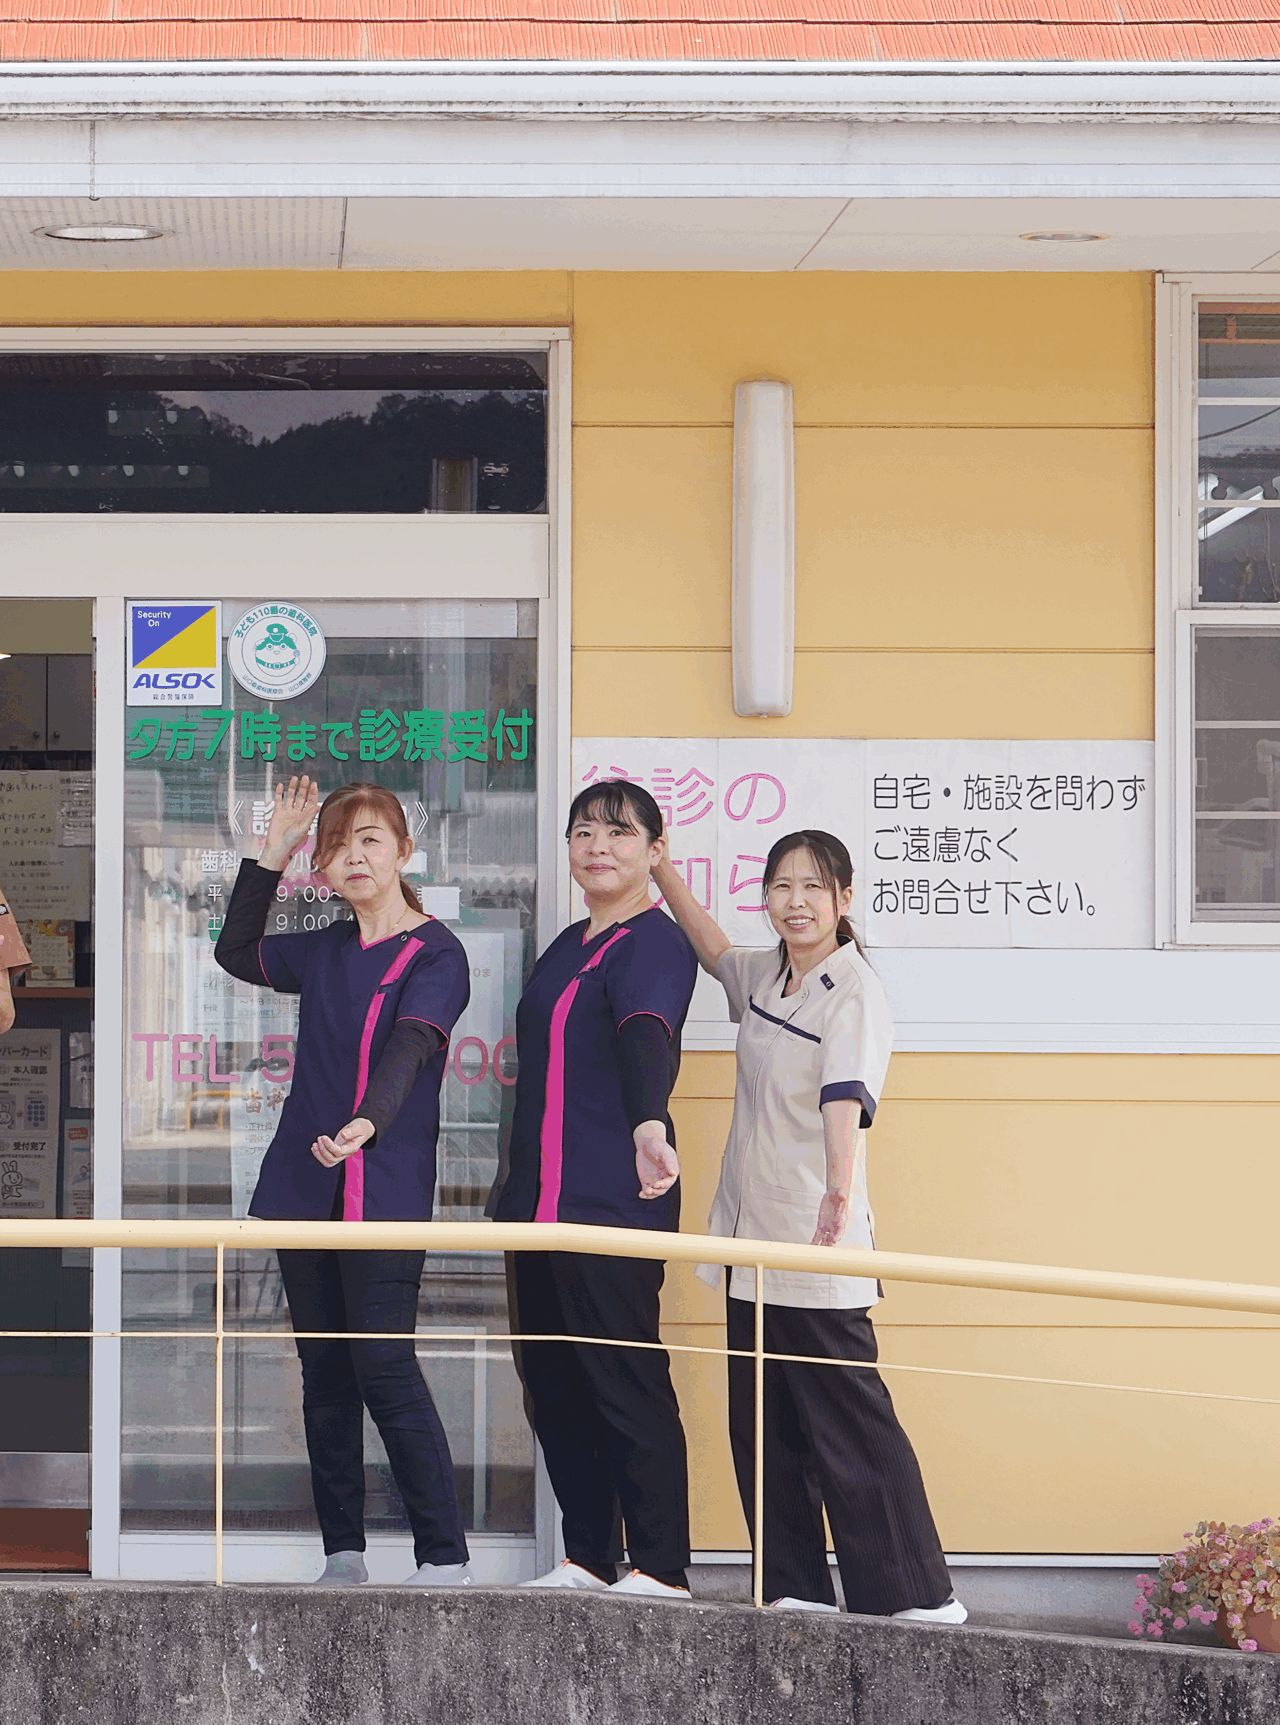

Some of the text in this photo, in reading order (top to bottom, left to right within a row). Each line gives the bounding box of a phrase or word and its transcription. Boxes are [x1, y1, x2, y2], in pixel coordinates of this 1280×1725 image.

[137, 610, 172, 619] Security
[148, 619, 160, 627] On
[132, 672, 216, 689] ALSOK
[130, 707, 533, 762] 夕方7時まで診療受付
[873, 773, 1146, 811] 自宅・施設を問わず
[873, 825, 1018, 862] ご遠慮なく
[872, 878, 1096, 916] お問合せ下さい。
[131, 1033, 240, 1083] TEL
[13, 1141, 46, 1151] 受付完了
